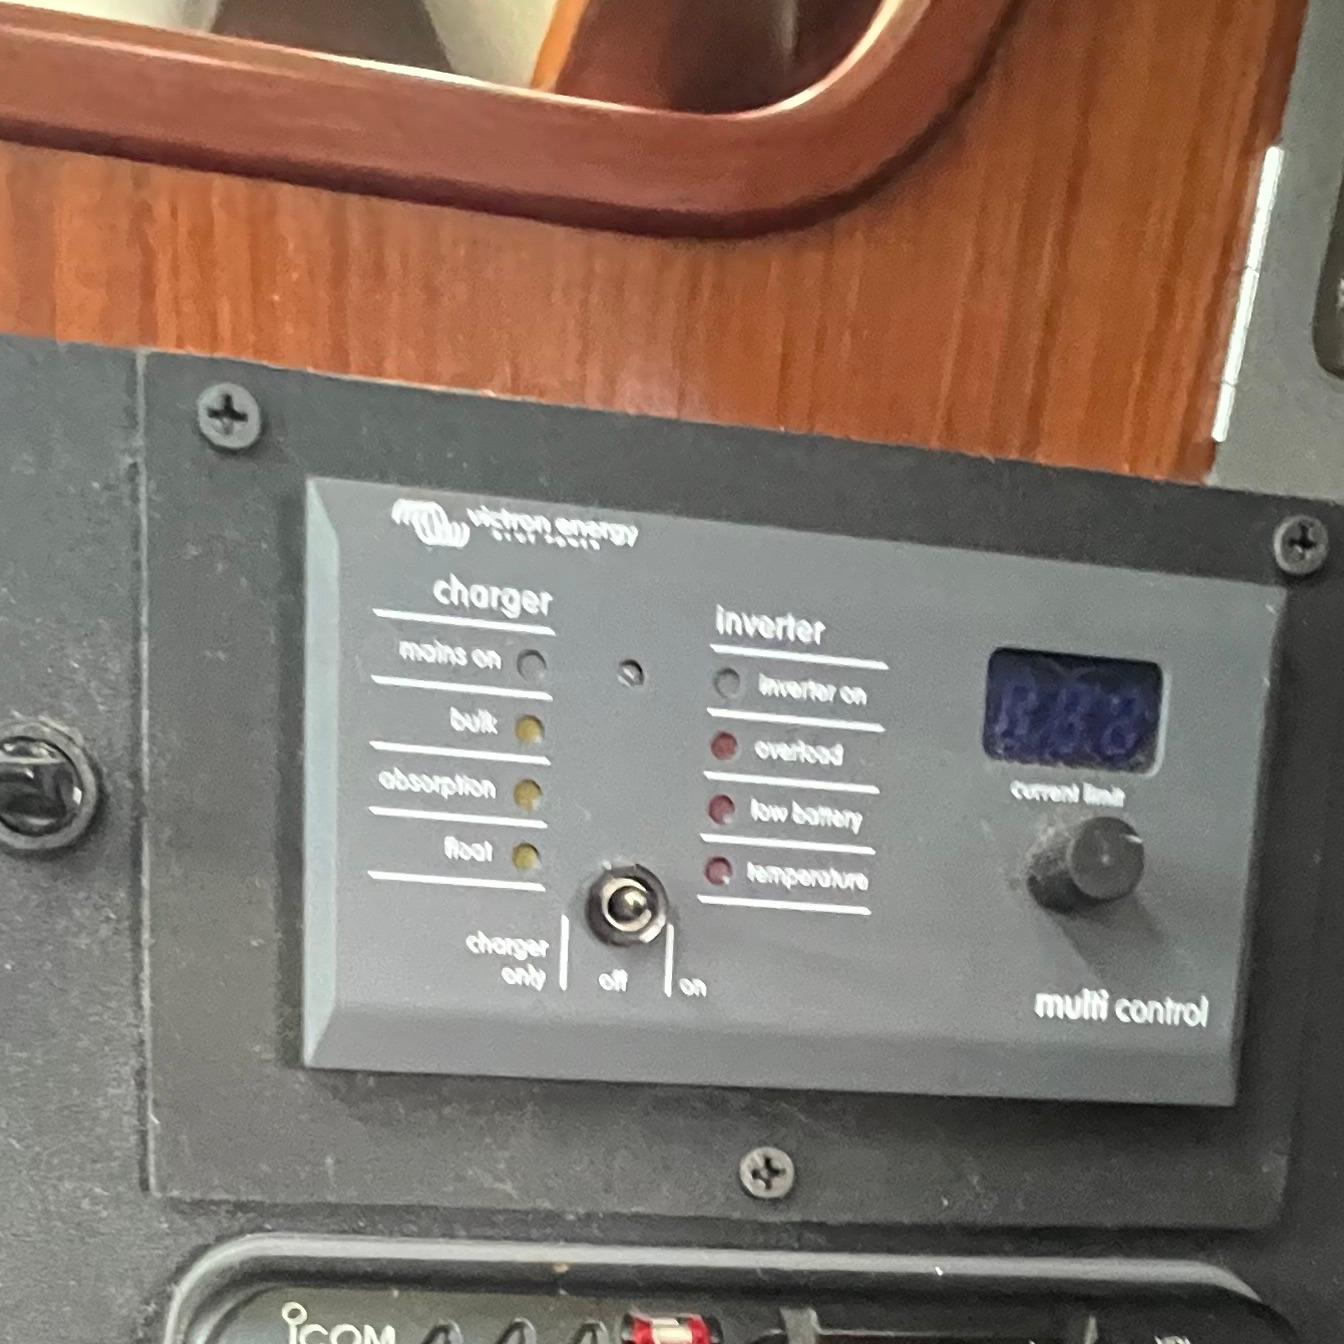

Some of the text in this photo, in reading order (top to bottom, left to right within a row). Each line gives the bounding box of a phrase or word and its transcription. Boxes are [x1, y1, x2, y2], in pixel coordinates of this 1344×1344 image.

[432, 572, 554, 619] charger
[398, 638, 502, 671] mains on
[840, 684, 868, 706] on
[449, 705, 499, 735] bulk
[754, 738, 844, 767] overload
[378, 767, 496, 799] absorption
[750, 797, 863, 835] low battery
[443, 835, 493, 863] float
[746, 860, 869, 892] temperature
[465, 929, 550, 960] charger
[500, 963, 548, 993] only
[598, 968, 629, 993] off
[678, 977, 708, 997] on
[1034, 988, 1210, 1028] multi control
